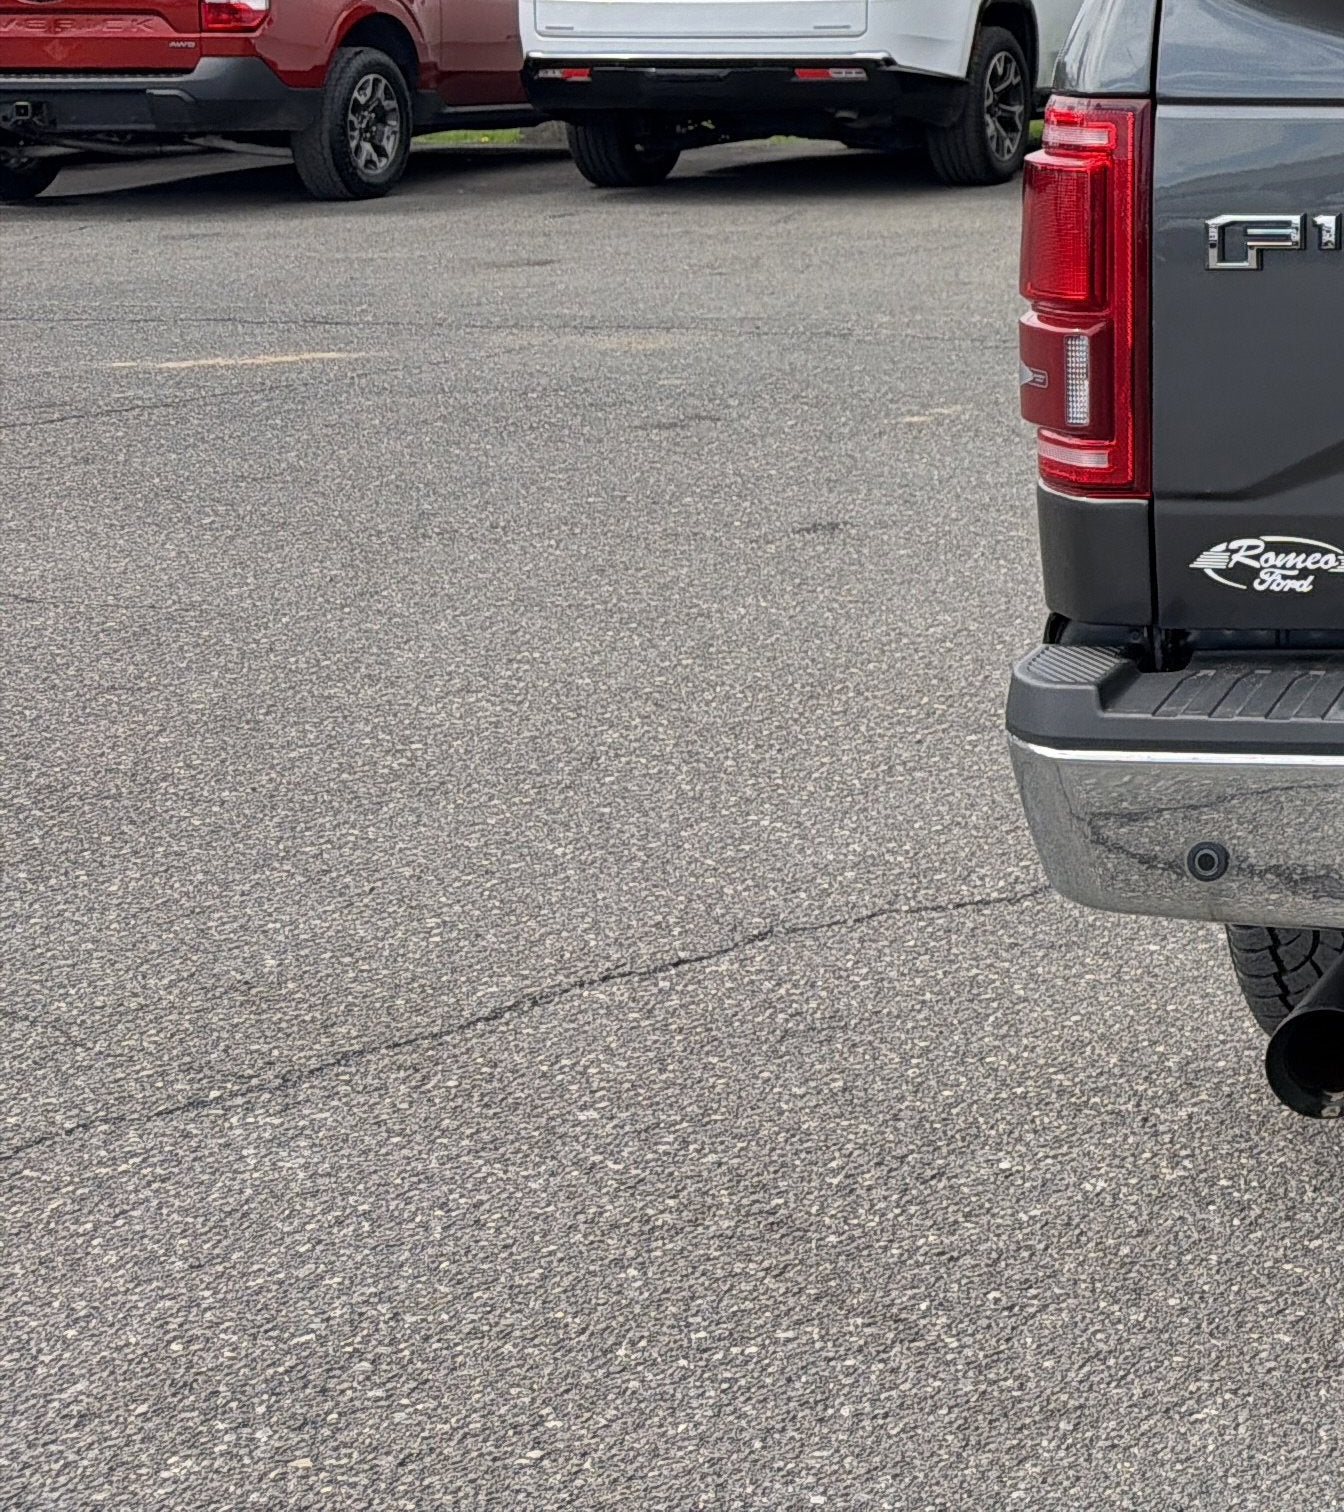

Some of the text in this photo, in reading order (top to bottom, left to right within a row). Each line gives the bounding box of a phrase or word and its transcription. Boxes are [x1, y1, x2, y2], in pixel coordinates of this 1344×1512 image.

[168, 41, 196, 49] AWD
[1228, 538, 1340, 570] Romeo
[1253, 568, 1315, 592] Ford
